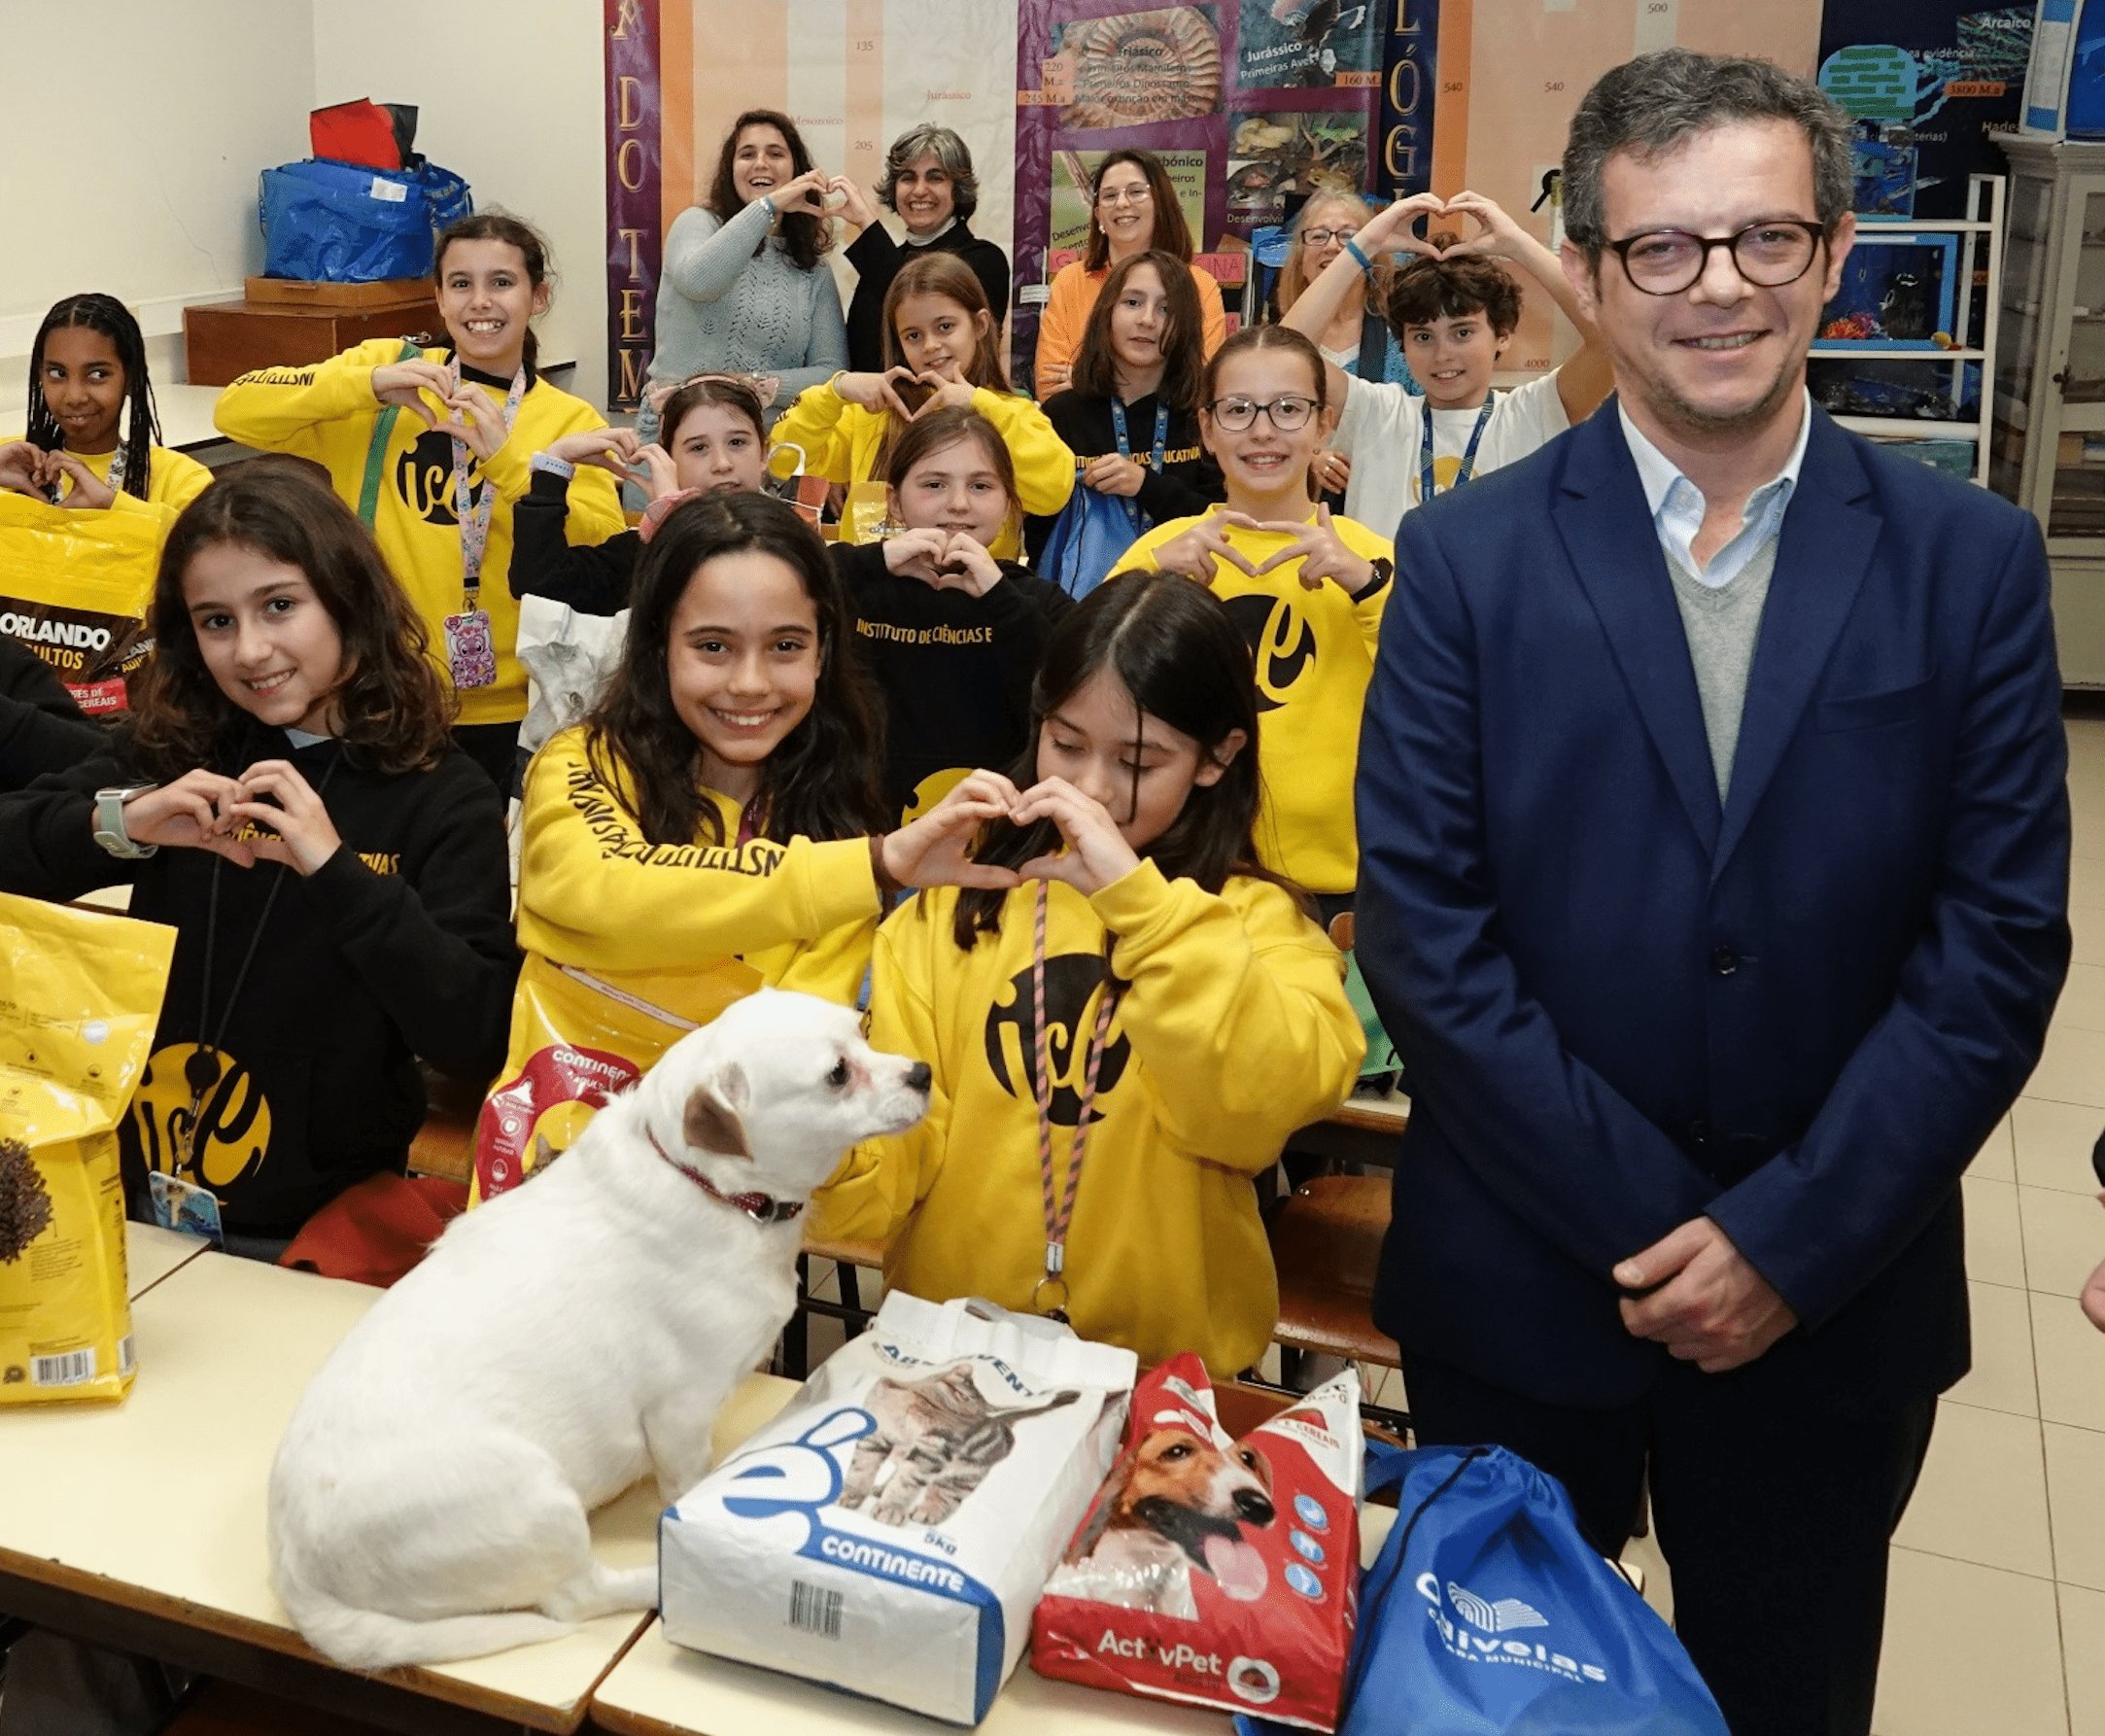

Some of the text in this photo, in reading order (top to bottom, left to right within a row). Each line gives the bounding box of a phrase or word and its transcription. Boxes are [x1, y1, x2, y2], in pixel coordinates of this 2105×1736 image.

[1648, 2, 1668, 14] 500
[855, 41, 875, 52] 135
[1247, 42, 1303, 63] Jurássico
[1044, 62, 1064, 72] 220
[1240, 62, 1290, 80] Primeiras
[1442, 82, 1464, 93] 540
[1544, 82, 1565, 92] 540
[616, 75, 646, 193] DO
[854, 140, 874, 152] 205
[1161, 155, 1204, 168] bónico
[1052, 221, 1091, 242] Desenvo
[0, 611, 113, 652] ORLANDO
[856, 617, 993, 645] INSTITUTO DE CIÊNCIAS E
